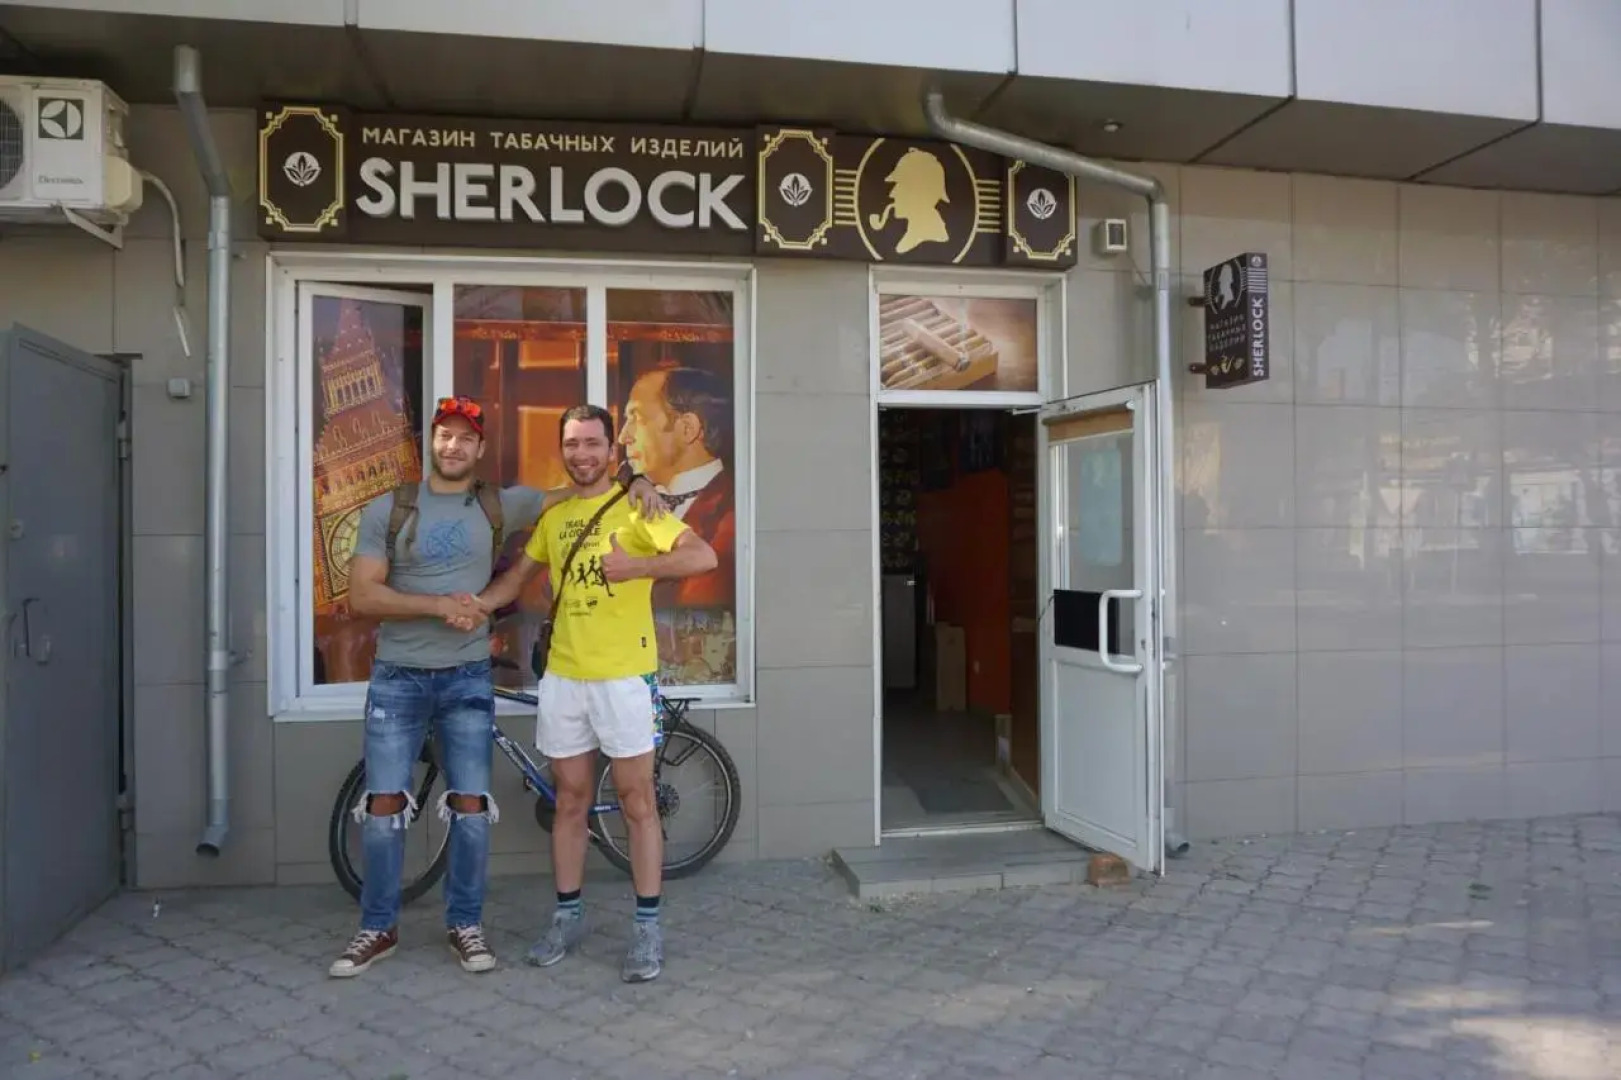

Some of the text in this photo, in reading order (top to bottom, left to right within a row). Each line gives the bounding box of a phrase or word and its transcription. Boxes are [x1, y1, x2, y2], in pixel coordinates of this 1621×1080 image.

[362, 127, 744, 159] МАГАЗИН ТАБАЧНЫХ ИЗДЕЛИЙ
[355, 157, 748, 230] SHERLOCK
[1252, 298, 1264, 377] SHERLOCK
